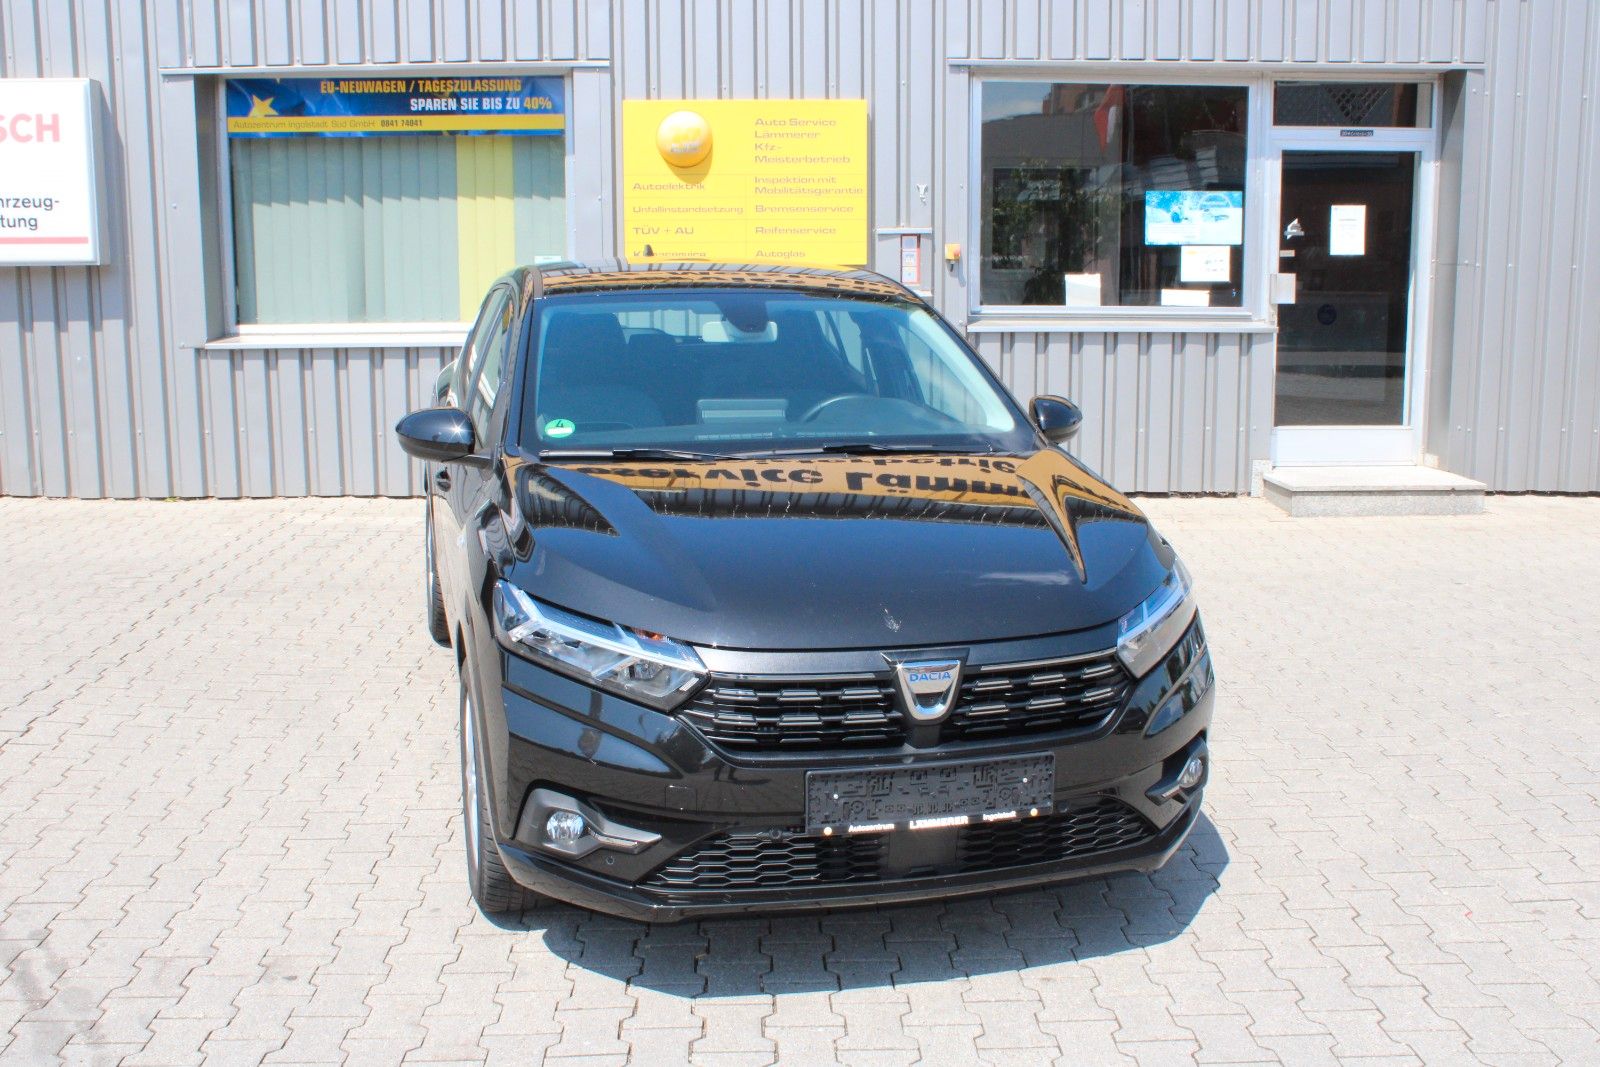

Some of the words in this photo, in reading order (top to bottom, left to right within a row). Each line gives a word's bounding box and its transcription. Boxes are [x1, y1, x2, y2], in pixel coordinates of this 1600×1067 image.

[320, 80, 406, 93] EU-NEUWAGEN
[409, 80, 415, 93] /
[417, 79, 522, 92] TAGESZULASSUNG
[410, 98, 457, 111] SPAREN
[460, 97, 479, 111] SIE
[482, 97, 503, 110] BIS
[505, 97, 520, 110] ZU
[523, 97, 552, 110] 40%
[349, 119, 375, 128] GmbH
[380, 119, 398, 128] 0841
[755, 118, 786, 126] Auto
[788, 118, 837, 126] Service
[754, 143, 782, 151] Kfz-
[754, 155, 850, 163] Meisterbetrieb
[755, 176, 815, 184] Inspektion
[633, 183, 705, 191] Autoelektrik
[632, 206, 744, 215] Unfallinstandsetzung
[755, 204, 854, 213] Bremsenservice
[633, 225, 660, 234] TÜV
[755, 226, 837, 234] Reifenservice
[755, 249, 806, 259] Autoglas
[555, 419, 564, 428] 4
[909, 671, 951, 682] DACIA
